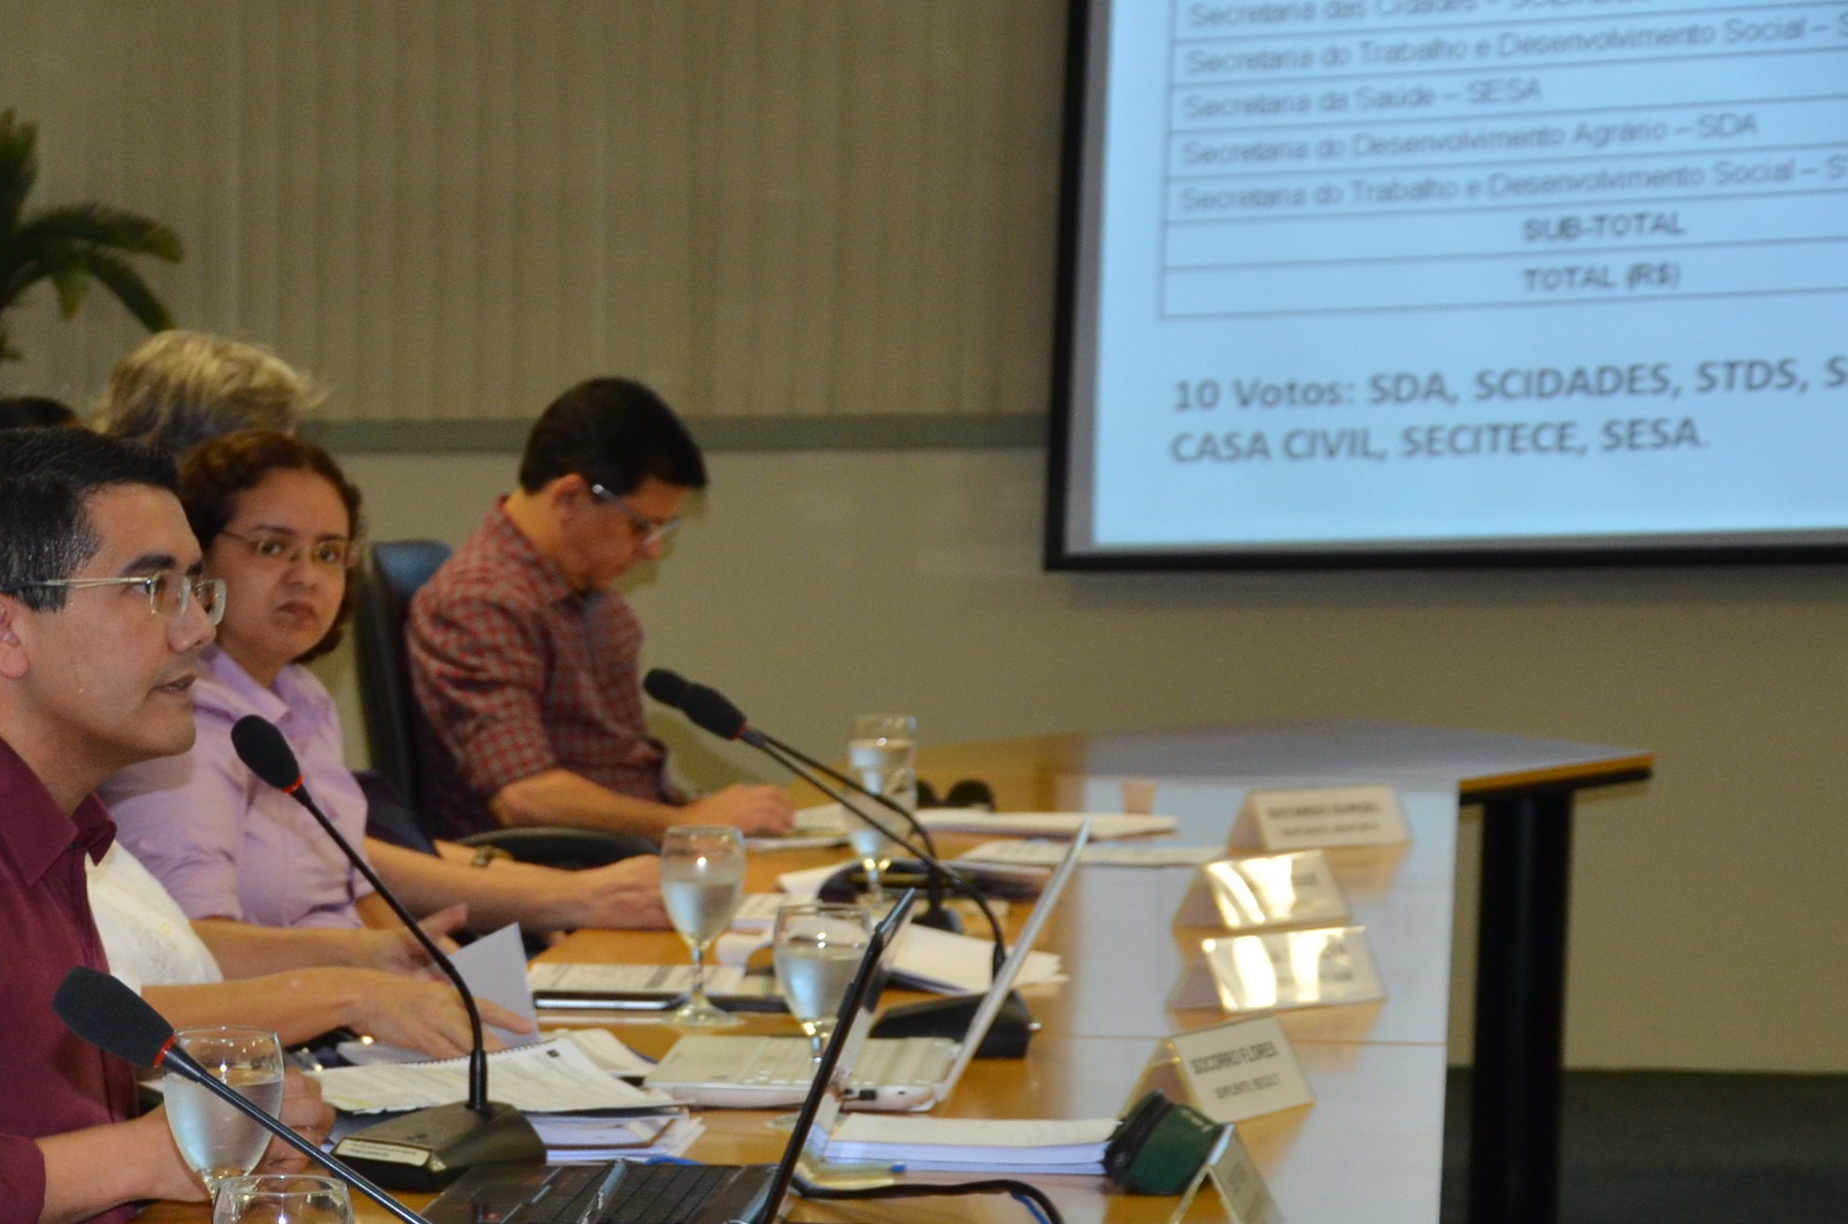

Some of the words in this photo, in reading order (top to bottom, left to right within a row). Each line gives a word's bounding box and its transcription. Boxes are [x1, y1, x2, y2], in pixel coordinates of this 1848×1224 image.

[1187, 49, 1315, 74] Secretaria
[1357, 38, 1467, 64] Trabalho
[1501, 24, 1717, 56] Desenvolvimento
[1724, 17, 1808, 44] Social
[1185, 94, 1312, 119] Secretaria
[1467, 78, 1542, 104] SESA
[1182, 141, 1309, 167] Secretaria
[1354, 125, 1565, 156] Desenvolvimento
[1698, 113, 1758, 138] SDA
[1180, 186, 1307, 212] Secretaria
[1351, 178, 1460, 205] Trabalho
[1488, 166, 1705, 196] Desenvolvimento
[1713, 159, 1796, 186] Social
[1523, 212, 1687, 242] SUB-TOTAL
[1523, 267, 1615, 292] TOTAL
[1625, 261, 1683, 290] (R$)
[1175, 379, 1220, 411] 10
[1233, 377, 1355, 409] Votos:
[1368, 371, 1460, 407] SDA,
[1474, 362, 1682, 401] SCIDADES,
[1696, 358, 1809, 394] STDS,
[1170, 431, 1271, 463] CASA
[1282, 428, 1386, 462] CIVIL,
[1402, 421, 1588, 457] SECITECE,
[1602, 416, 1710, 451] SESA.
